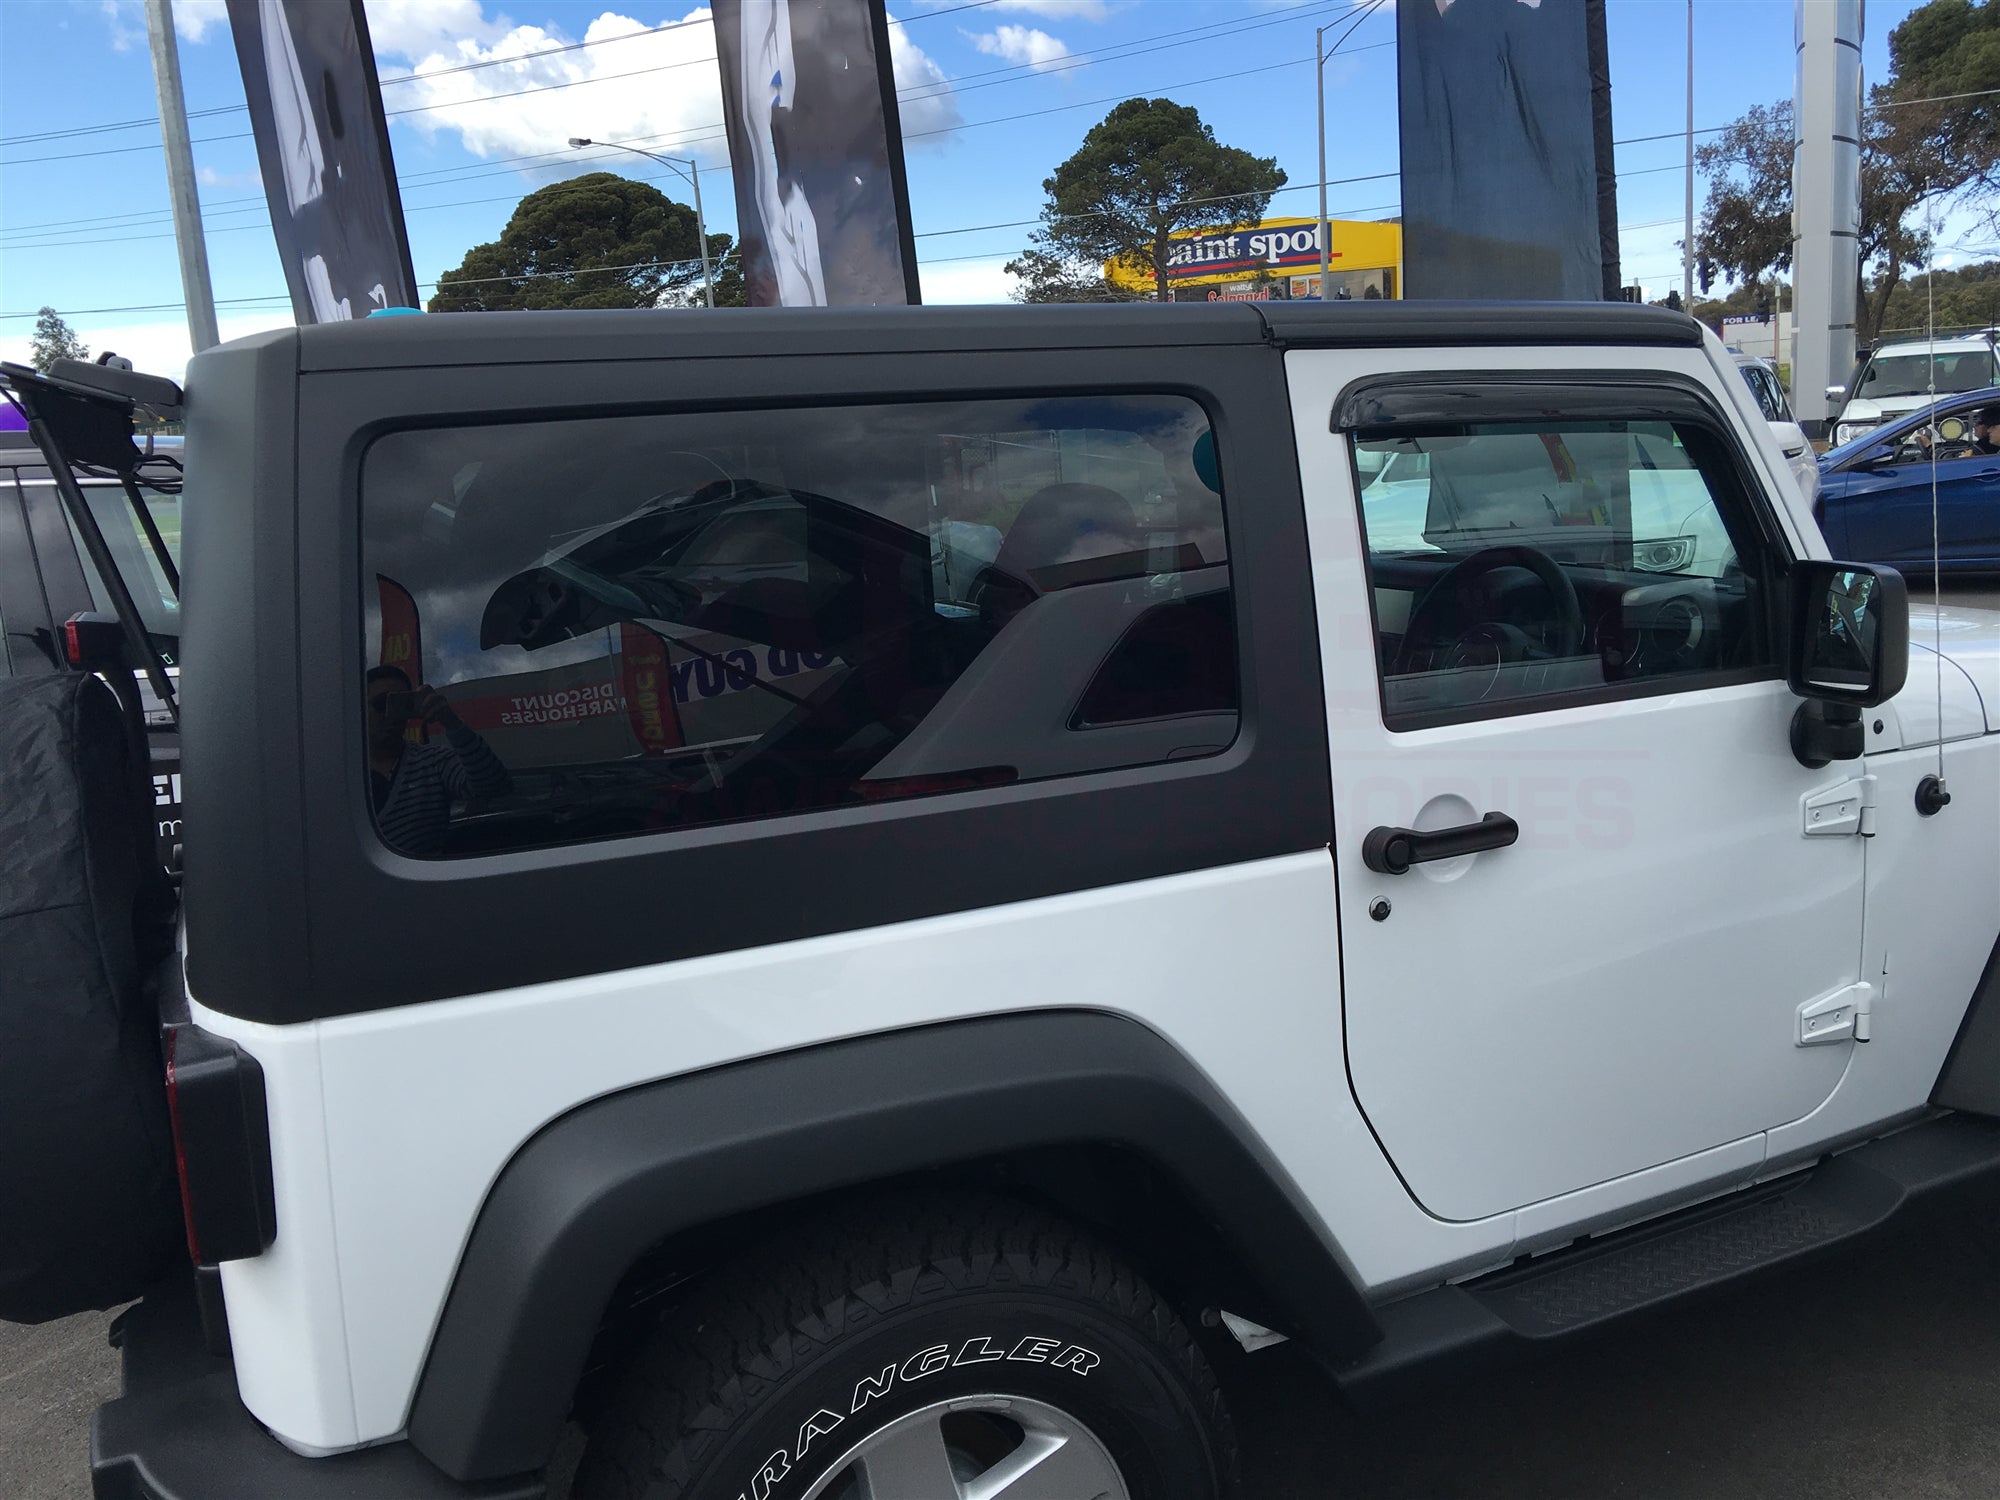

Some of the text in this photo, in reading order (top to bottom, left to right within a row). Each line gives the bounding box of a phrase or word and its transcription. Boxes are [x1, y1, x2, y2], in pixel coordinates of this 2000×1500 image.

[1249, 223, 1321, 264] spot
[1723, 314, 1775, 325] FOR LEE
[737, 1336, 1101, 1500] RANGLER
